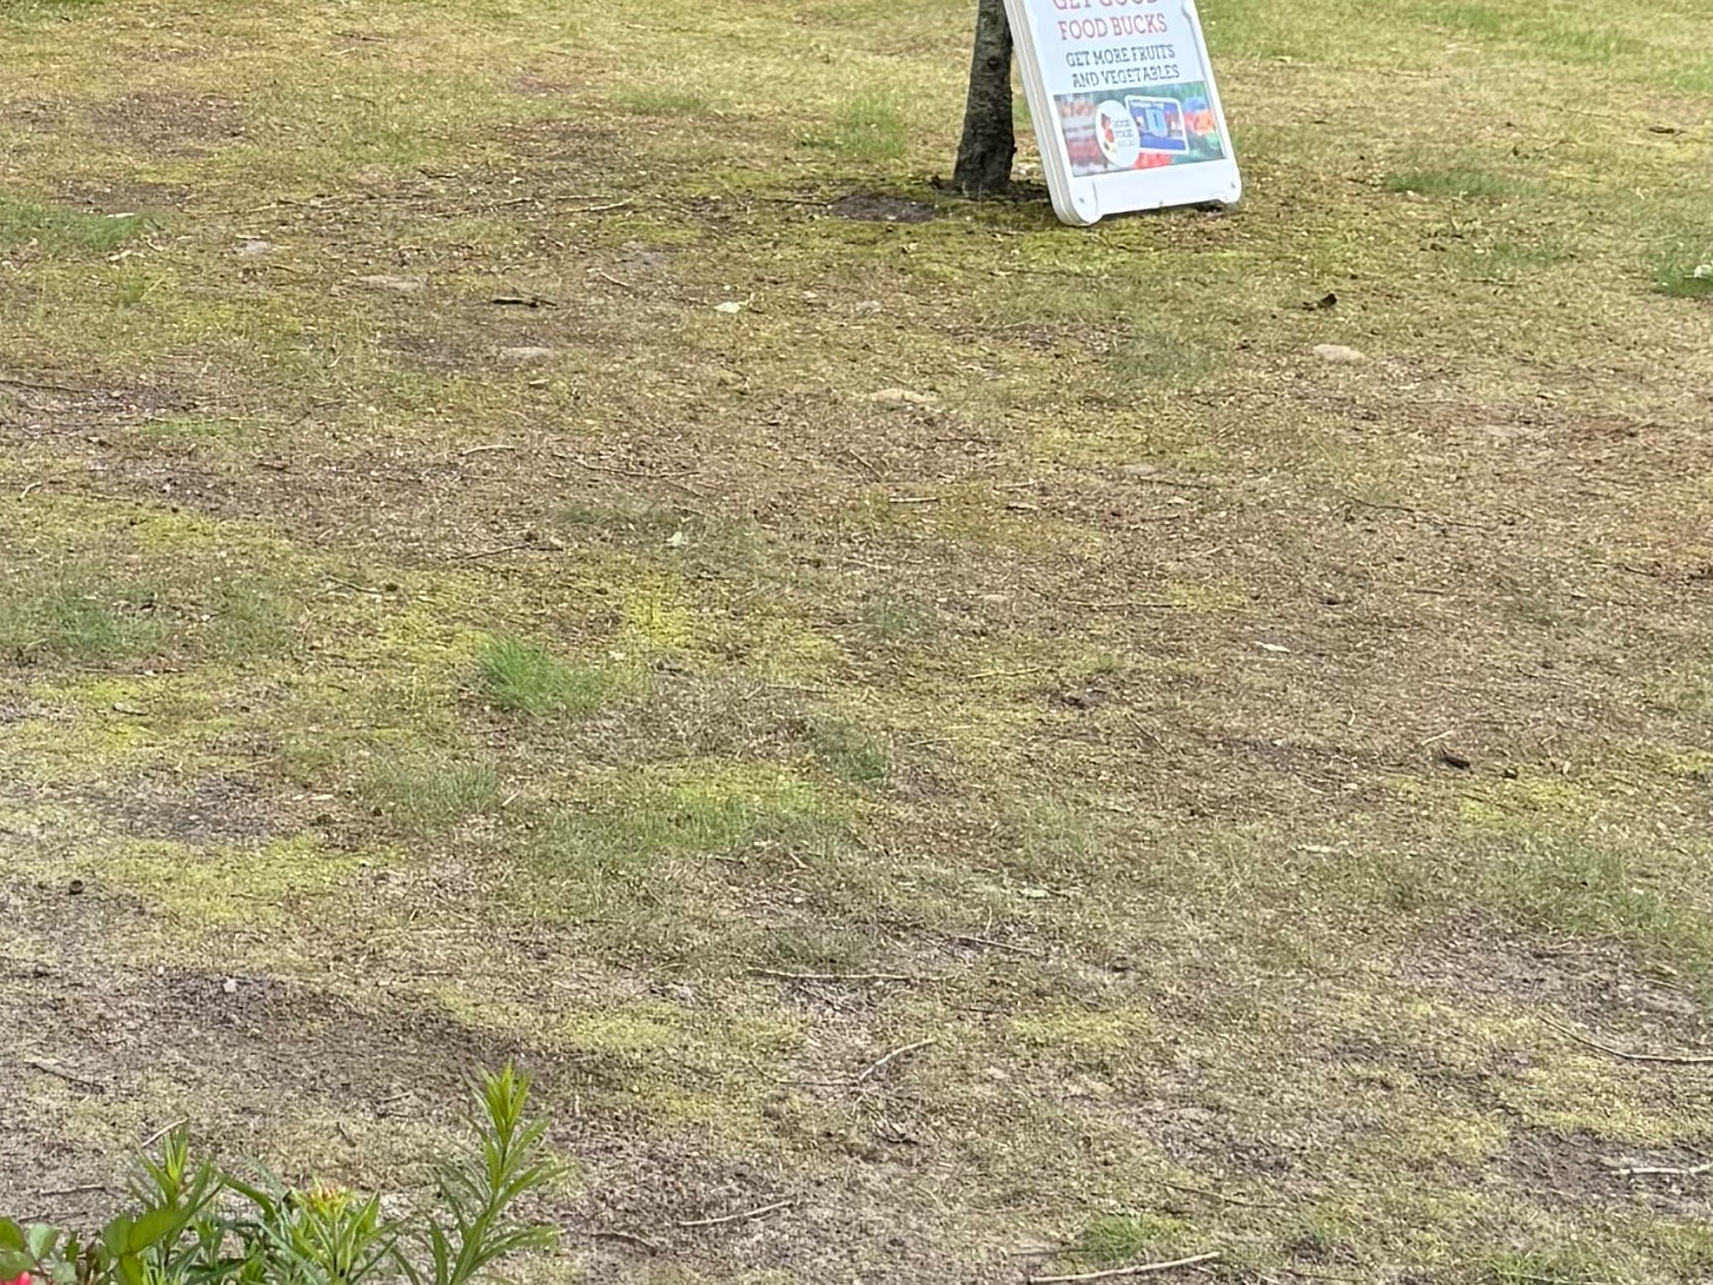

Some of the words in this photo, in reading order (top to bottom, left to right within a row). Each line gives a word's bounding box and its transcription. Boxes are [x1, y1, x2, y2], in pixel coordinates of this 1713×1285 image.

[1057, 17, 1108, 41] FOOD
[1109, 12, 1168, 36] BUCKS
[1065, 50, 1091, 67] GET
[1091, 47, 1131, 65] MORE
[1130, 43, 1176, 62] FRUITS
[1072, 71, 1099, 88] AND
[1100, 63, 1181, 86] VEGETABLES
